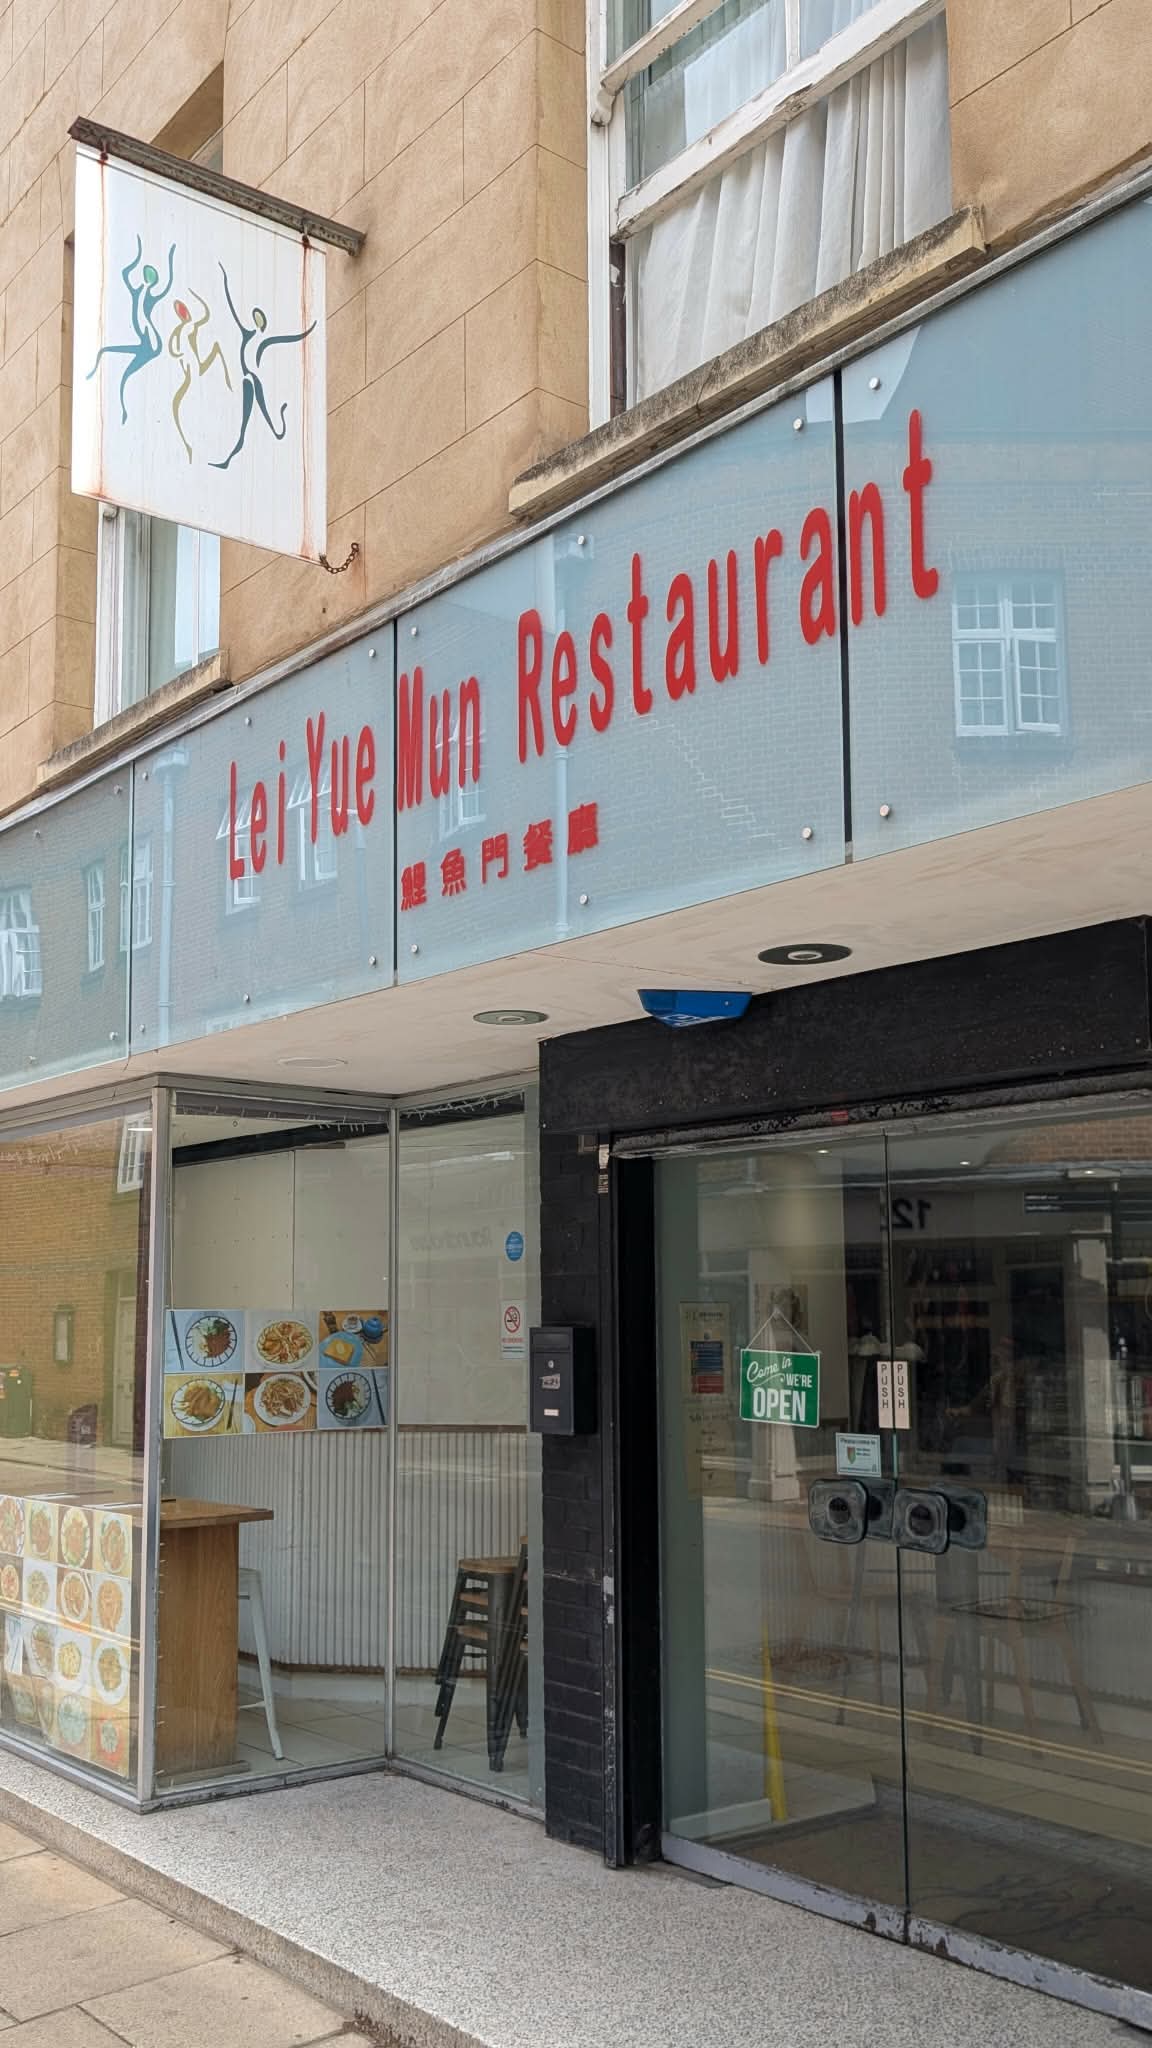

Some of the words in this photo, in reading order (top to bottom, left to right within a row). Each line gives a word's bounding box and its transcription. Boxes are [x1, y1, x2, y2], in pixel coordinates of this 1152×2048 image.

[229, 739, 287, 882] Lei
[306, 711, 377, 844] Yue
[397, 666, 481, 813] Mun
[517, 408, 940, 764] Restaurant
[400, 802, 599, 911] 鯉魚門餐廳
[746, 1360, 780, 1383] Come
[782, 1356, 793, 1369] in
[786, 1373, 812, 1388] WE'RE
[880, 1363, 889, 1409] PUSH
[897, 1363, 905, 1409] PUSH
[753, 1386, 806, 1422] OPEN
